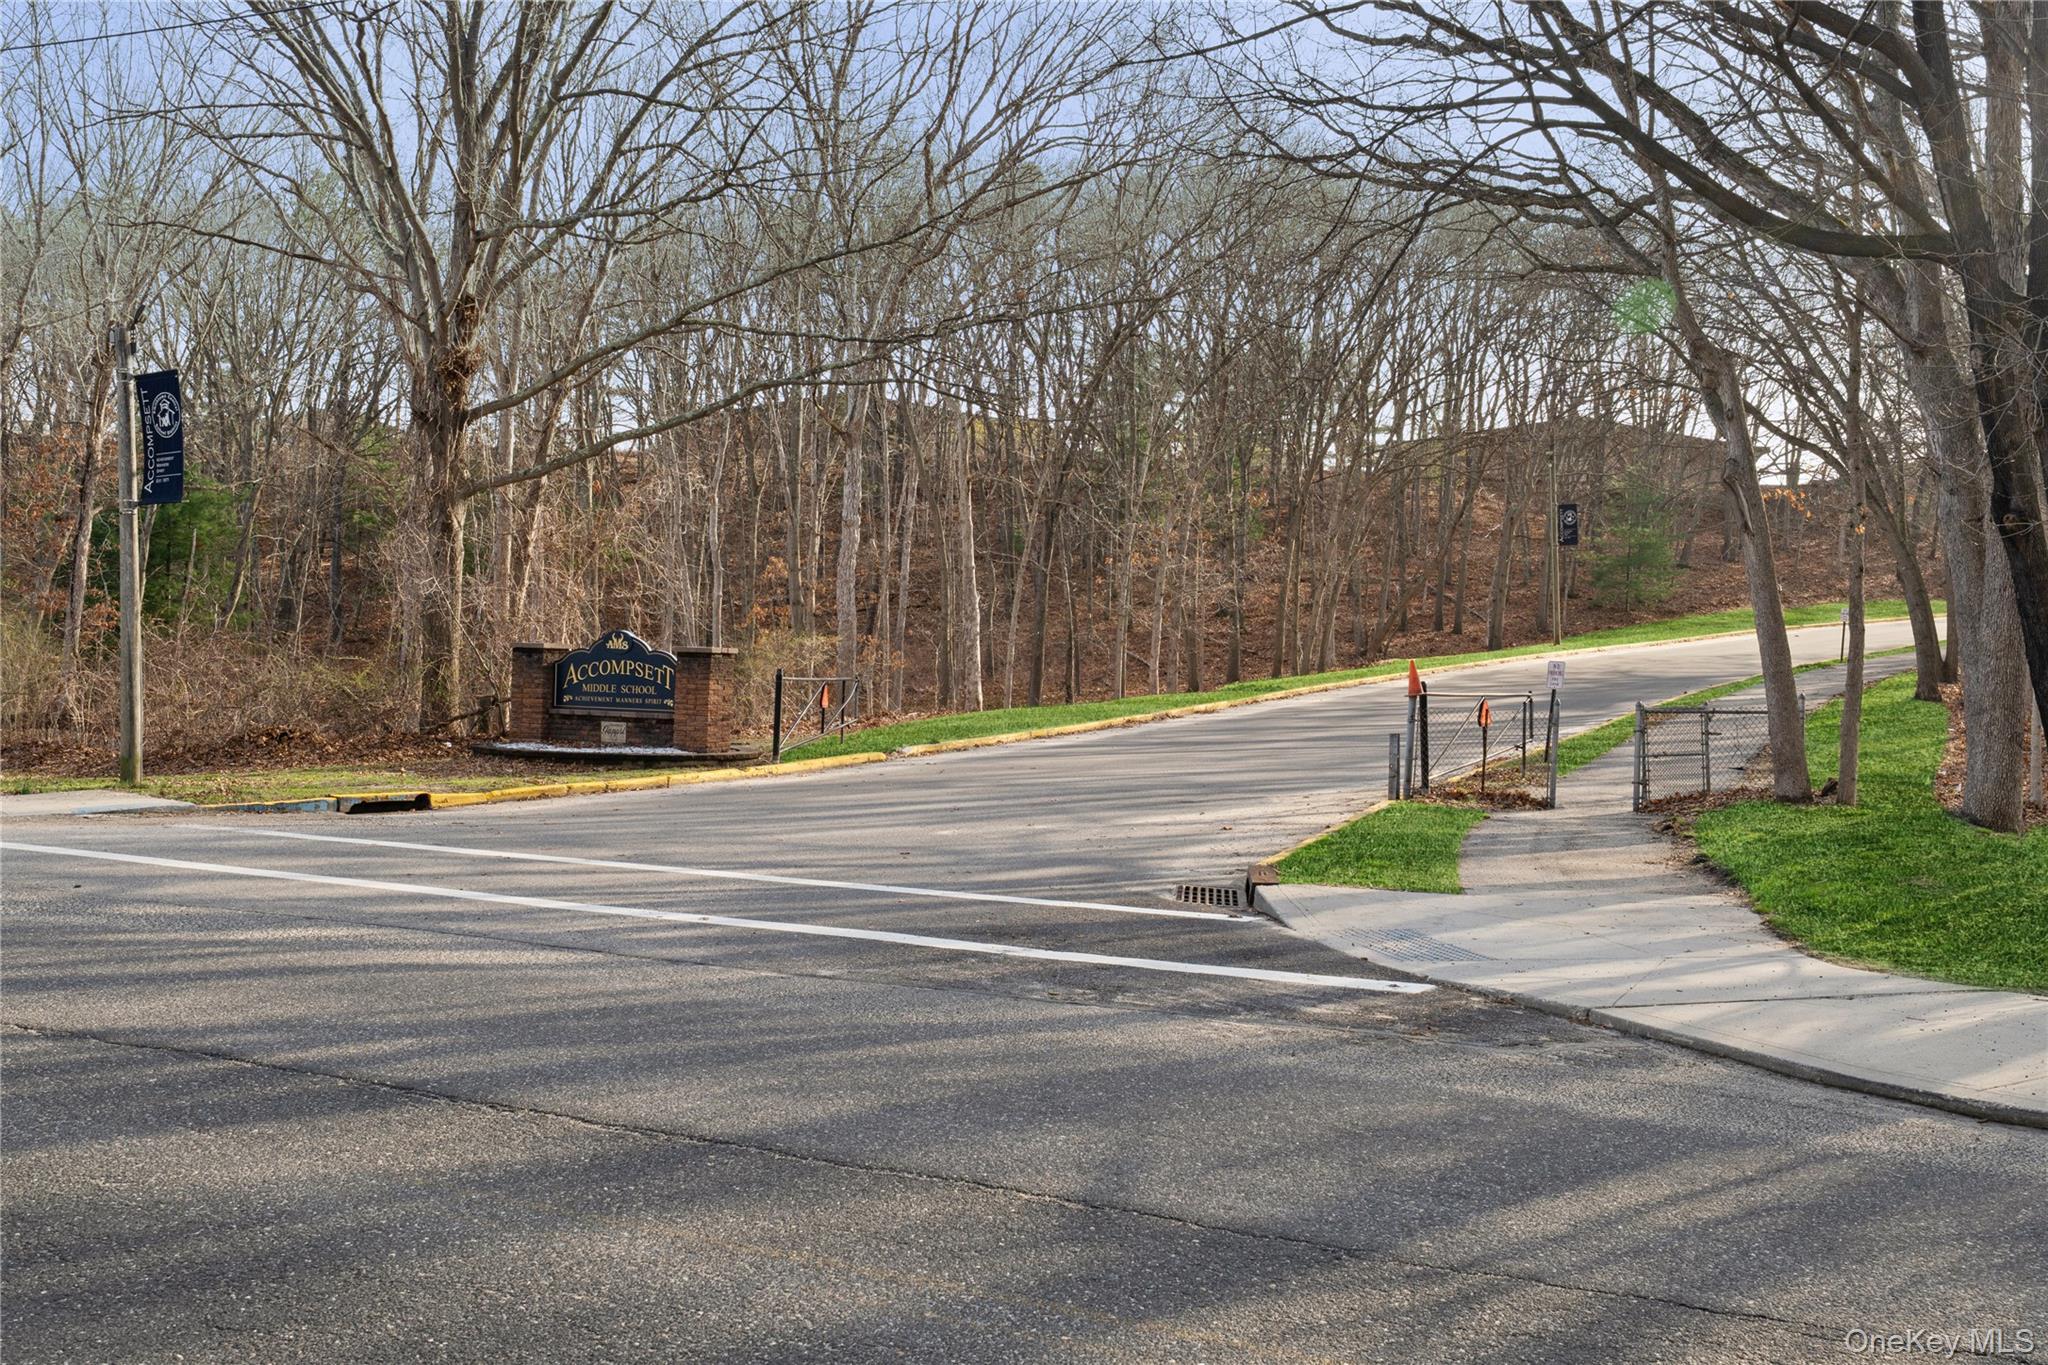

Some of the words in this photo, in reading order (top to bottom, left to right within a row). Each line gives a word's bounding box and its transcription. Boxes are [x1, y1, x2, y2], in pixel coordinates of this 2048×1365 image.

[140, 387, 155, 493] ACCOMPSETT
[606, 640, 629, 650] AMS
[562, 659, 675, 690] ACCOMPSETT
[582, 683, 617, 694] MIDDLE
[620, 684, 657, 695] SCHOOL
[574, 695, 613, 703] ACHIEVEMENT
